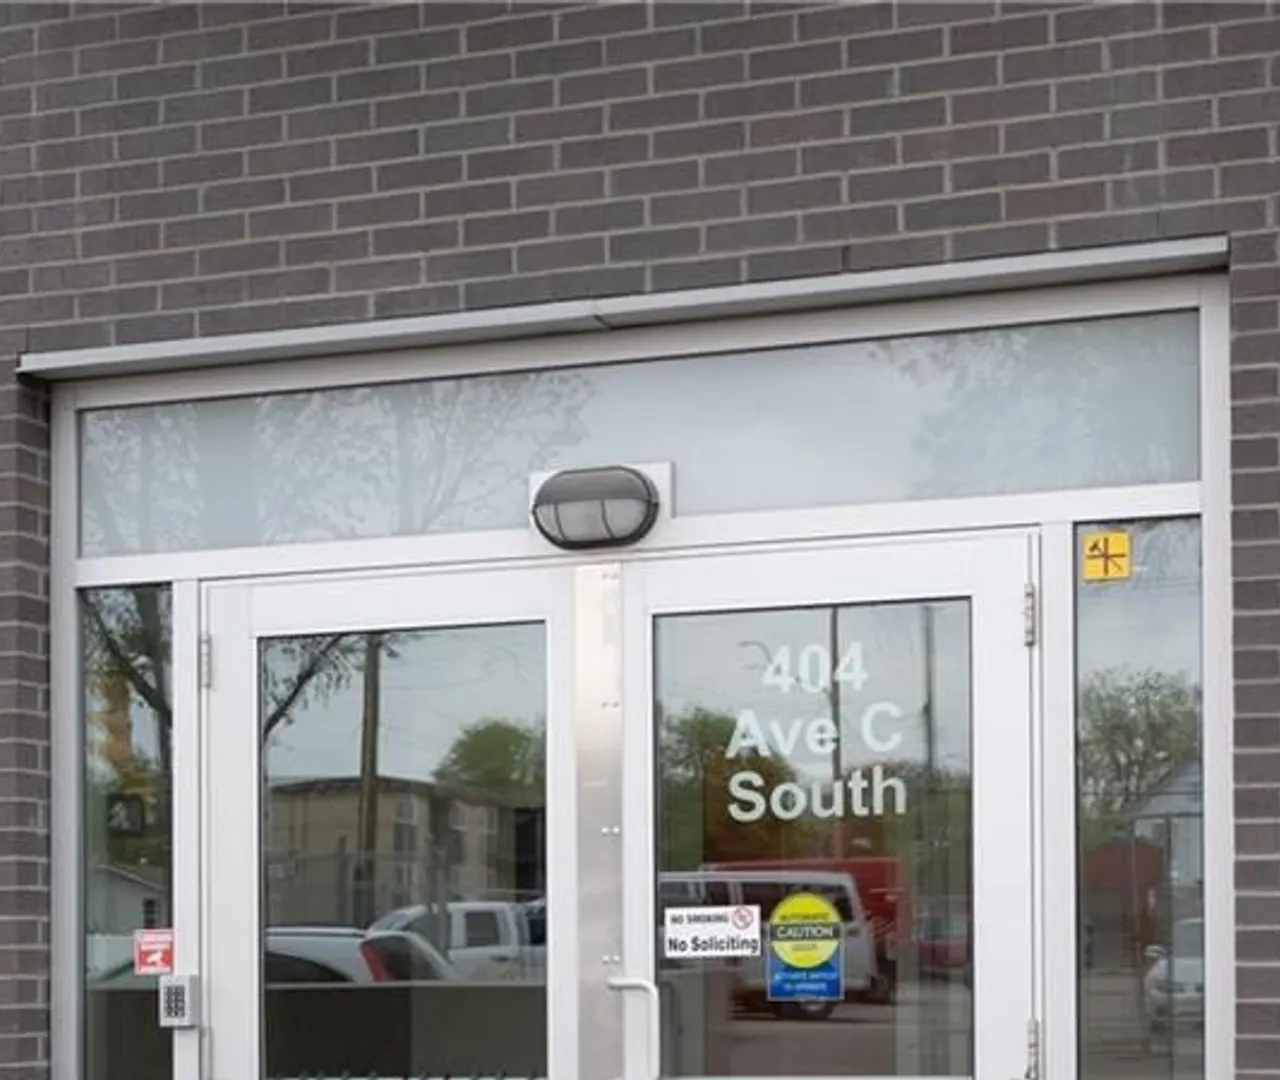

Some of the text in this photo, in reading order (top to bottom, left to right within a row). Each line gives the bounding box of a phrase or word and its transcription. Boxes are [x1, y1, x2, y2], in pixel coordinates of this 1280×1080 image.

[761, 641, 869, 693] 404
[724, 701, 904, 759] Ave C
[727, 764, 907, 822] South
[670, 912, 730, 924] NO SMOKING
[776, 926, 833, 938] CAUTION
[668, 936, 758, 953] No Soliciting
